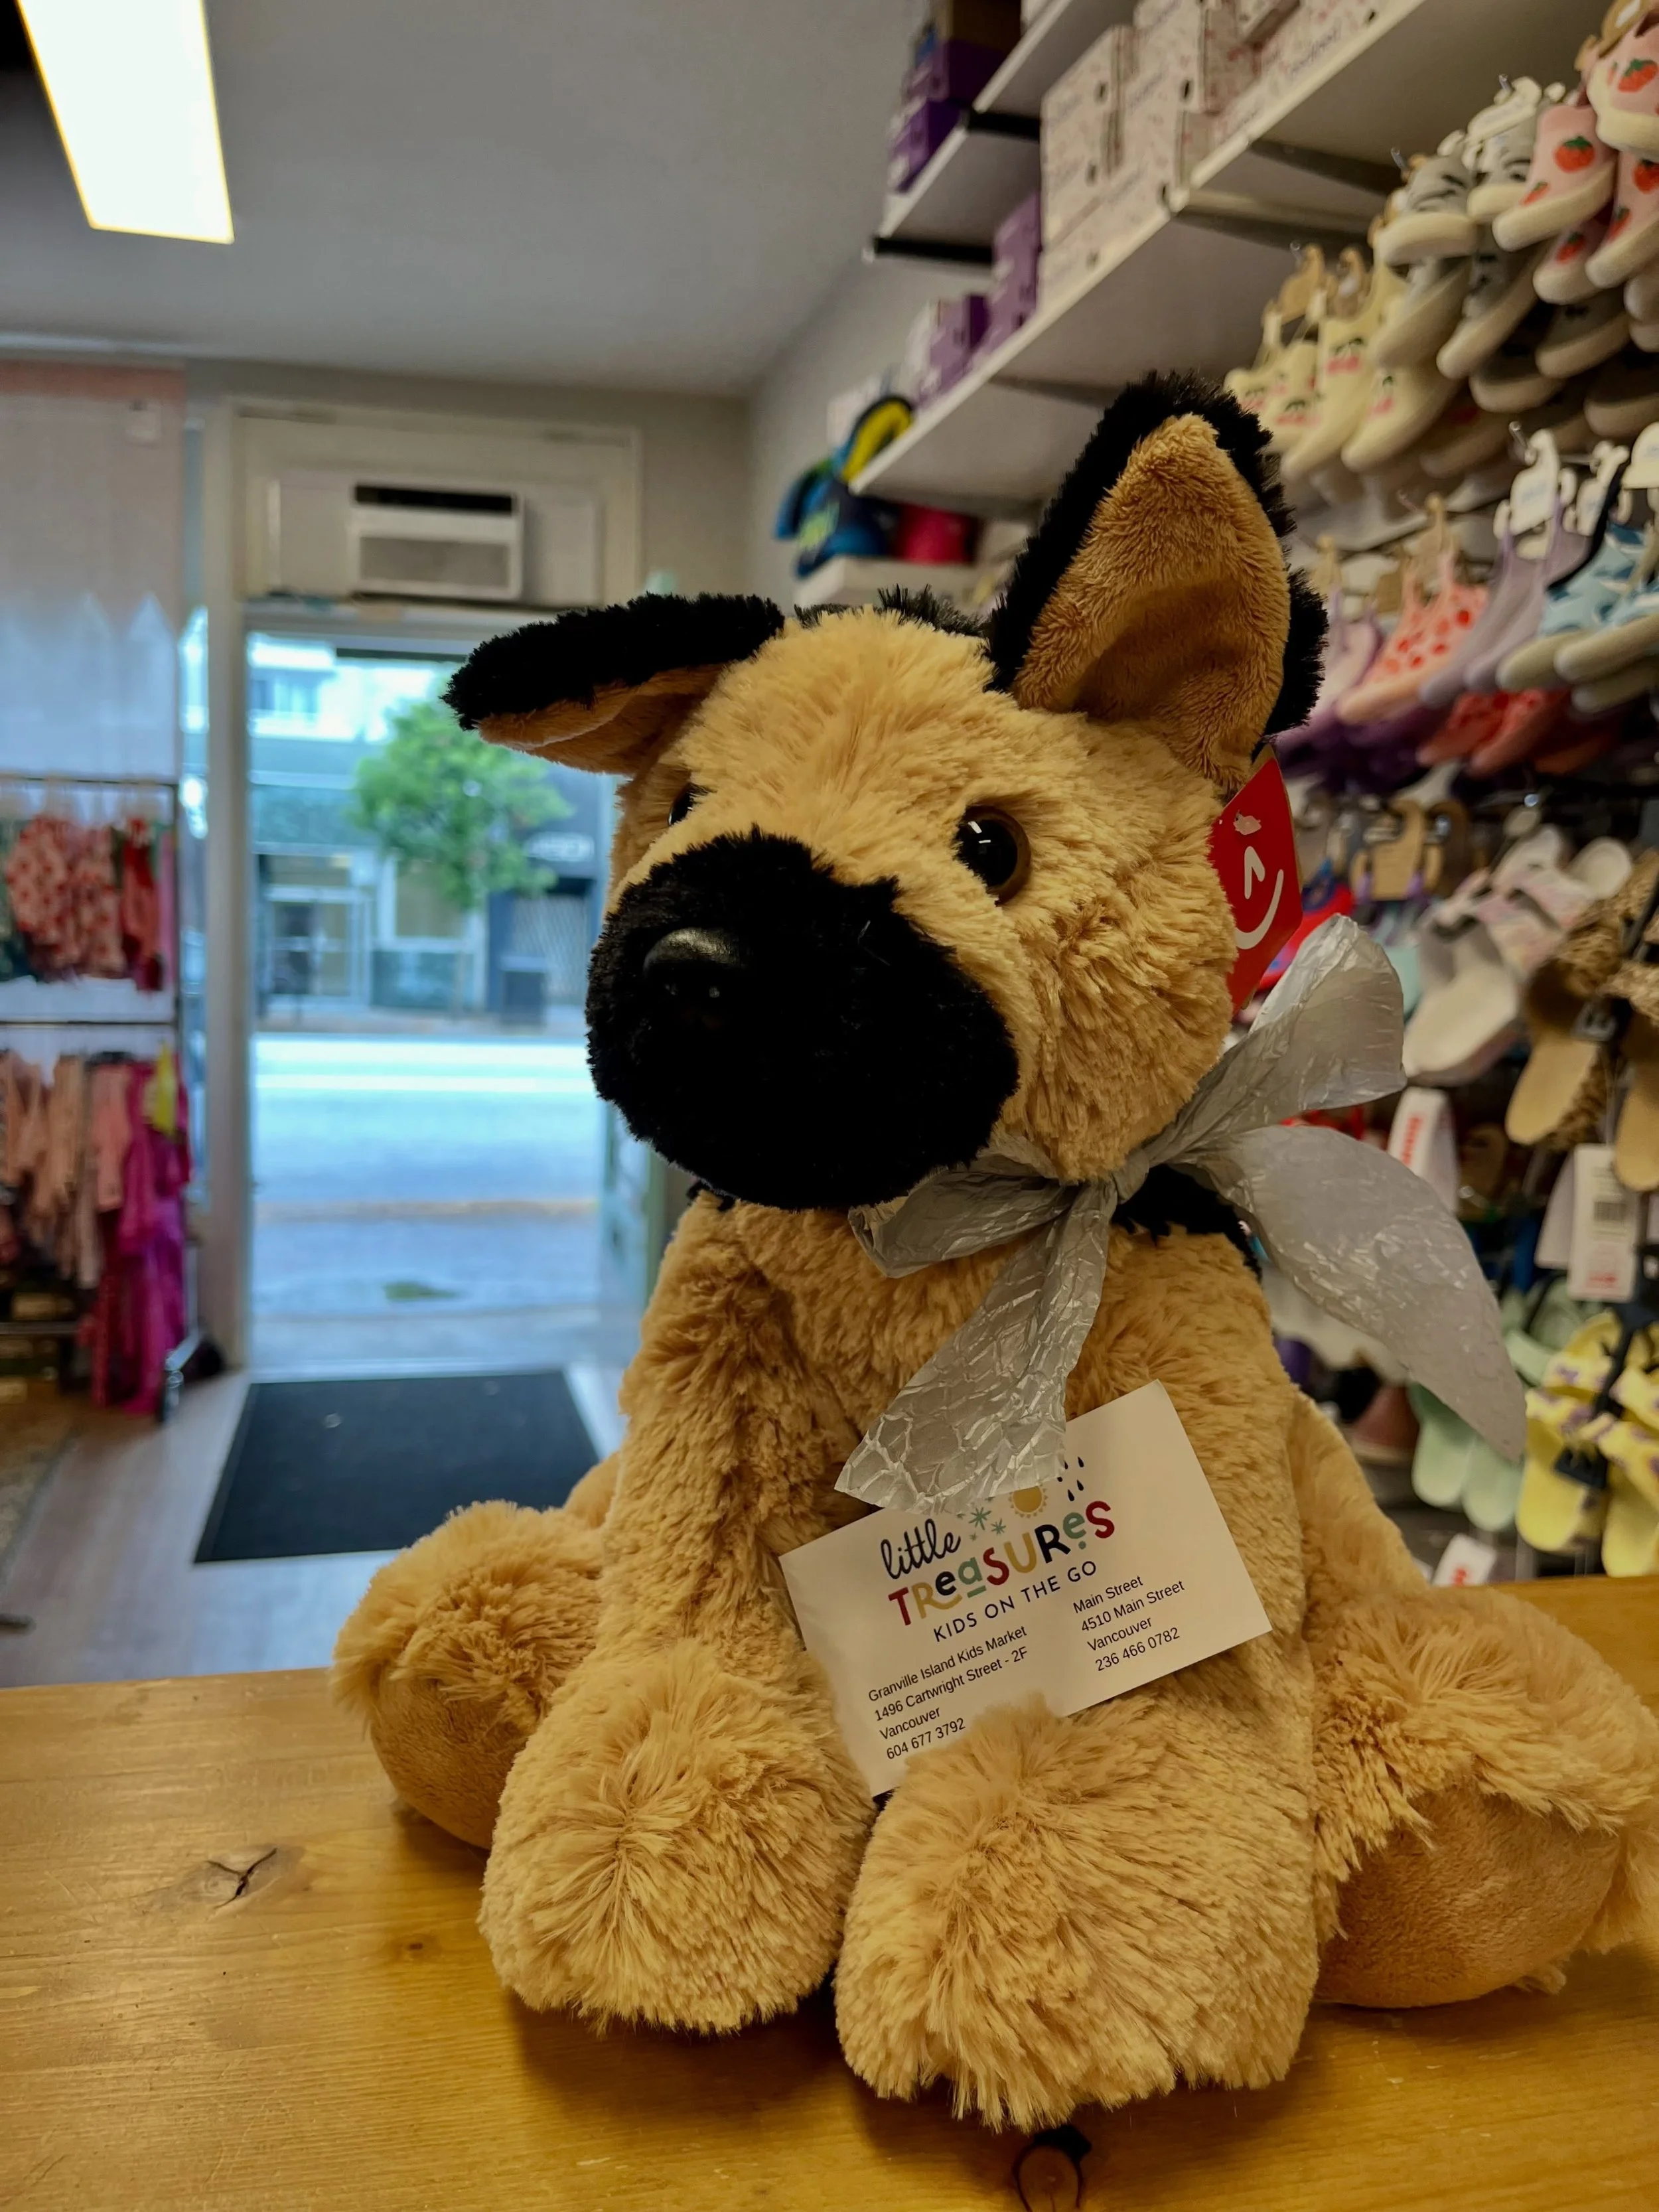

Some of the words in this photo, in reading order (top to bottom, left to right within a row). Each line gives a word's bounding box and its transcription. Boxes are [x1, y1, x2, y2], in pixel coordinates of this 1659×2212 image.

[881, 1518, 961, 1580] little
[934, 1612, 977, 1642] KIDS
[984, 1595, 1015, 1619] ON
[1021, 1576, 1061, 1603] THE
[1067, 1561, 1096, 1582] GO
[1073, 1593, 1104, 1613] Main
[1105, 1576, 1143, 1599] Street
[1082, 1611, 1112, 1632] 4510
[1114, 1599, 1145, 1619] Main
[1146, 1580, 1185, 1603] Street
[1087, 1617, 1152, 1651] Vancouver
[1095, 1653, 1119, 1671] 236
[1122, 1641, 1145, 1659] 466
[1147, 1627, 1180, 1649] 0782
[868, 1672, 918, 1701] Granville
[920, 1655, 956, 1680] Island
[957, 1645, 983, 1664] Kids
[985, 1626, 1027, 1652] Market
[875, 1700, 903, 1722] 1496
[905, 1675, 965, 1708] Cartwright
[966, 1659, 1003, 1682] Street
[1011, 1646, 1028, 1662] 2F
[879, 1707, 940, 1739] Vancouver
[887, 1742, 908, 1759] 604
[911, 1731, 932, 1749] 677
[935, 1718, 966, 1739] 3792
